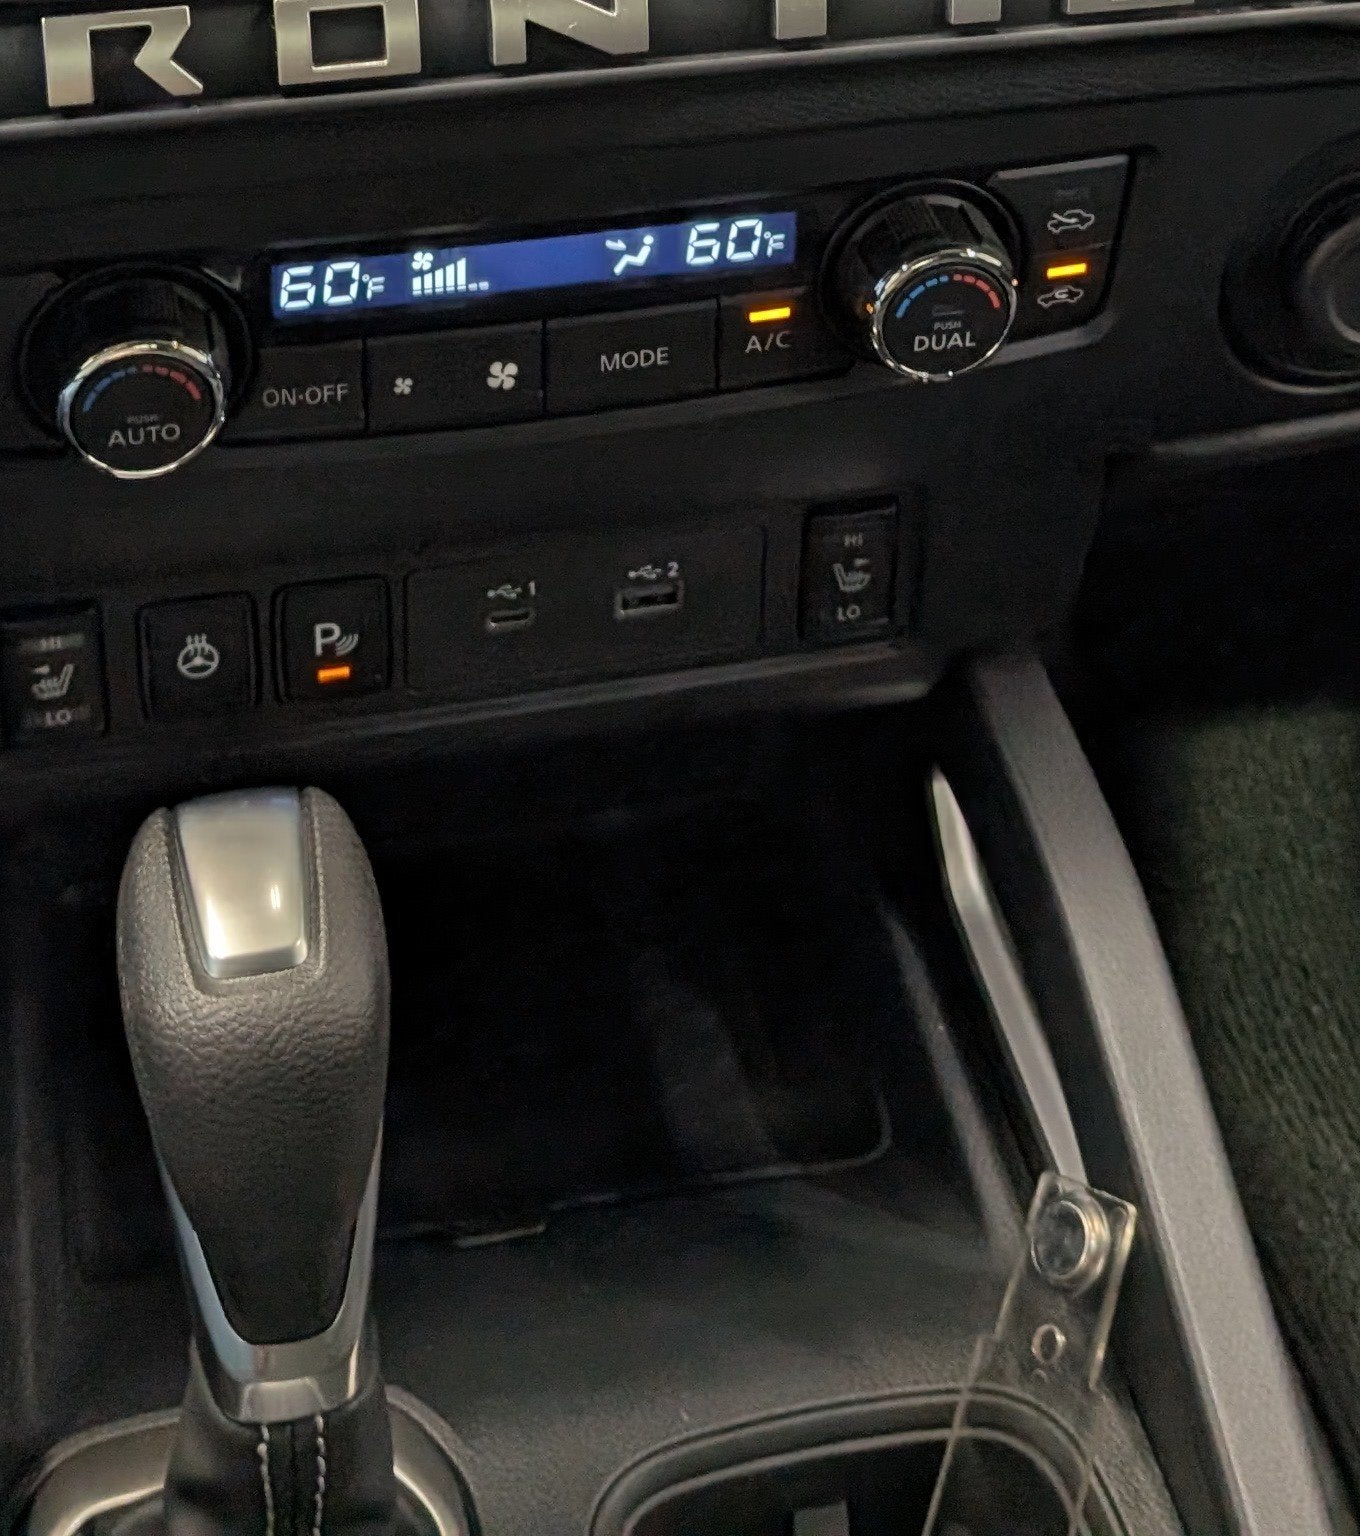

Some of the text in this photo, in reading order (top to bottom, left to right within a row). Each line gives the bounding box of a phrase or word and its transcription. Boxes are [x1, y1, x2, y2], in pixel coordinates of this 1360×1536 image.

[744, 328, 792, 354] A/C
[913, 330, 976, 352] DUAL
[599, 346, 670, 373] MODE
[107, 423, 181, 448] AUTO
[667, 562, 680, 578] 2
[836, 605, 861, 622] LO
[44, 710, 72, 728] LO
